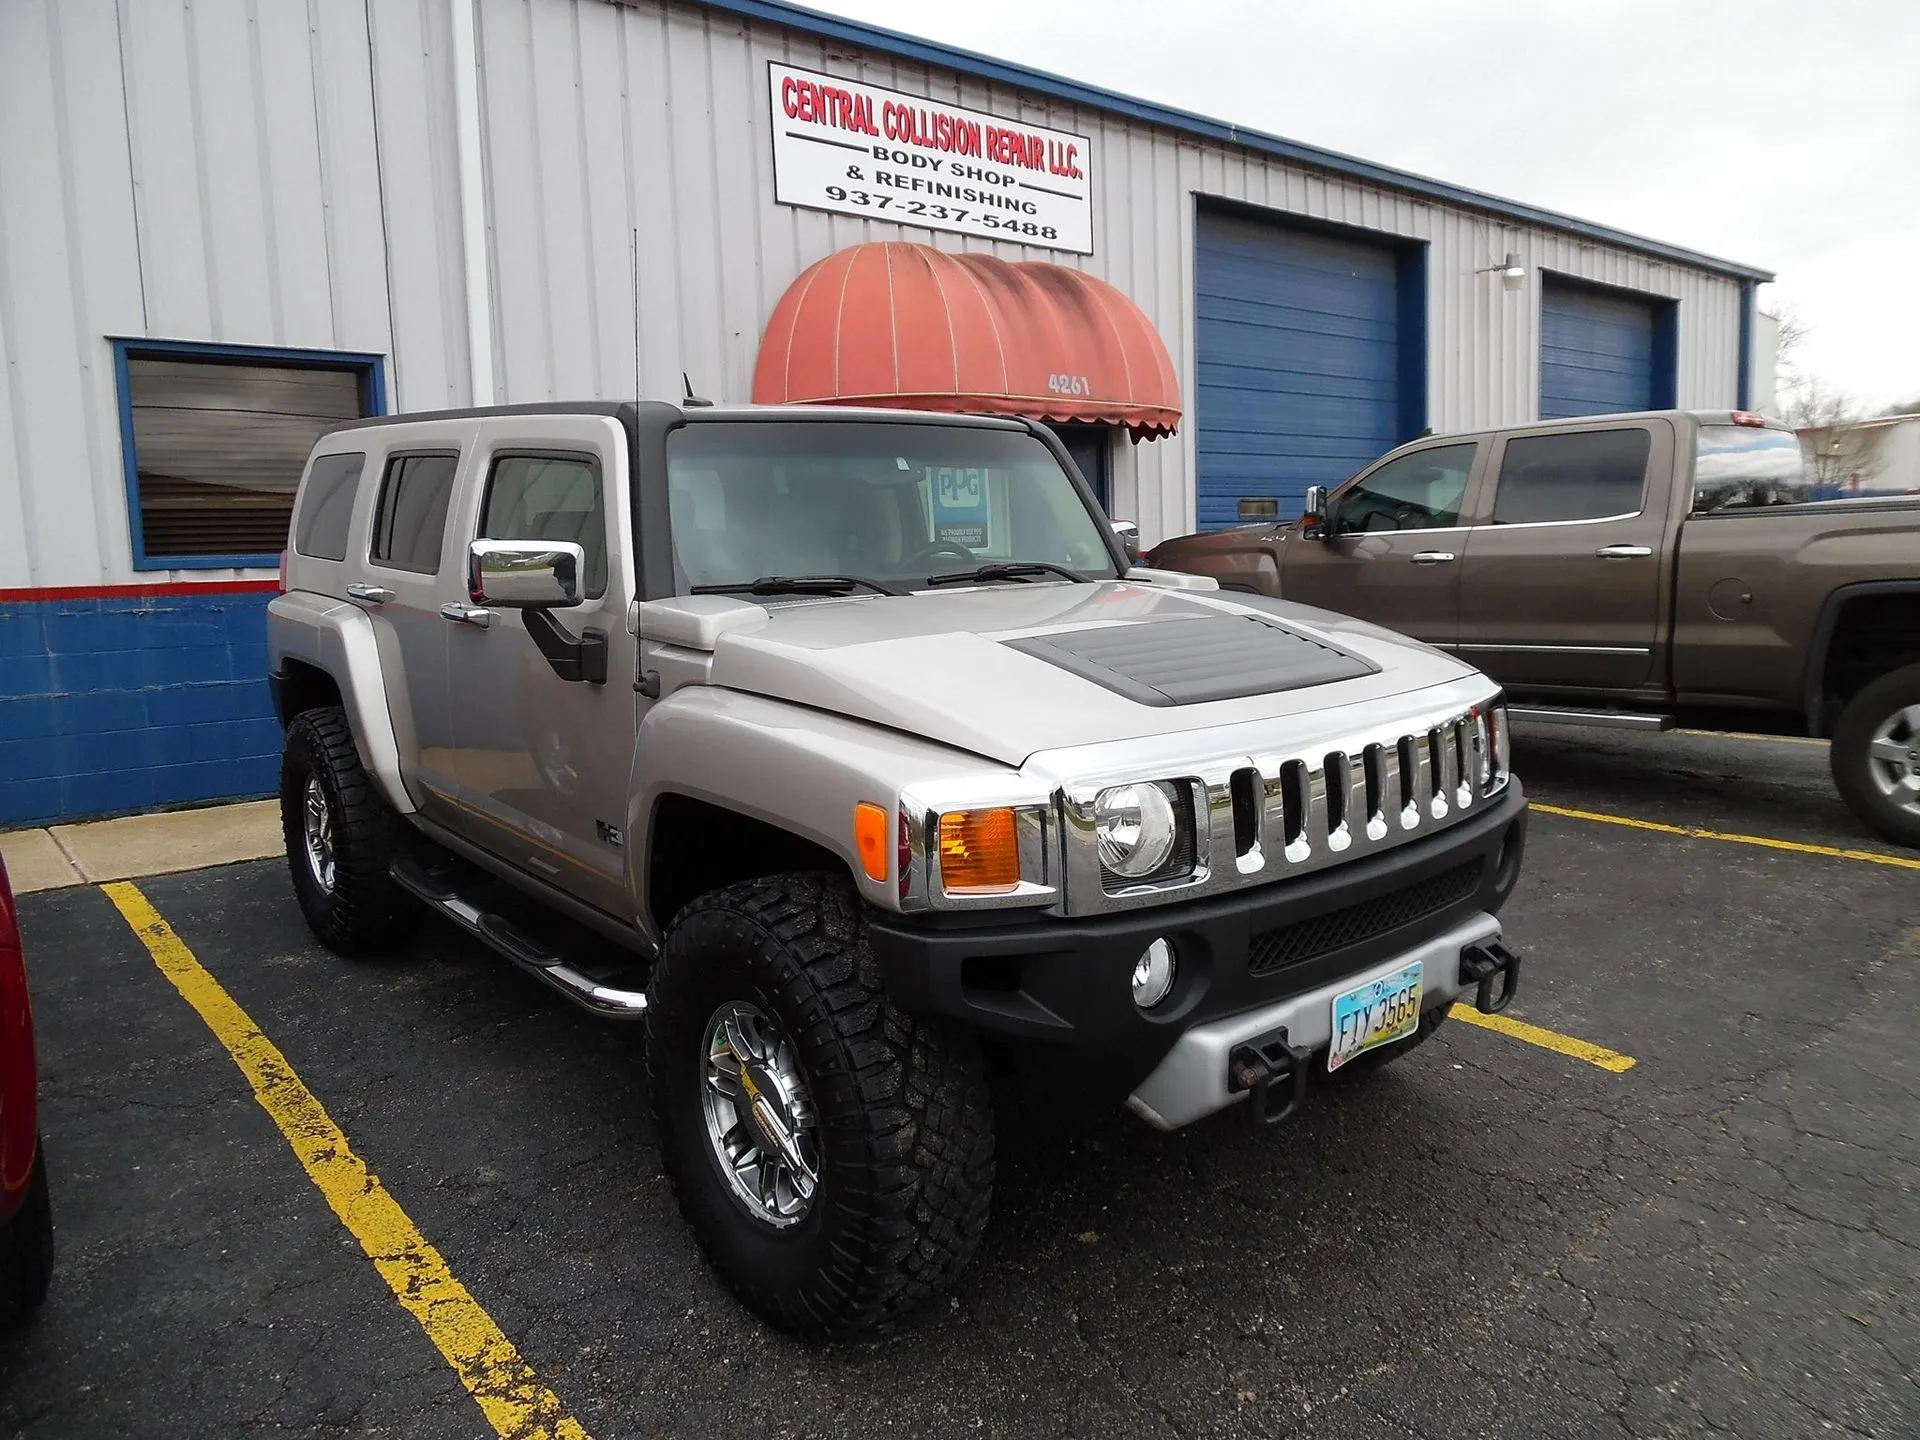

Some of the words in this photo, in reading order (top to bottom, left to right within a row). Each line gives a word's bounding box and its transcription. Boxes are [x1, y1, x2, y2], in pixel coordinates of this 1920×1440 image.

[782, 76, 879, 137] CENTRAL
[882, 100, 982, 159] COLLISION
[986, 124, 1046, 172] REPAIR
[846, 165, 864, 181] &
[876, 171, 1038, 215] REFINISHING
[873, 145, 943, 172] BODY
[950, 163, 1016, 188] SHOP
[825, 185, 1058, 240] 937-237-5488
[1048, 374, 1090, 395] 4261
[940, 469, 979, 501] PPG
[1374, 983, 1417, 1032] 3565
